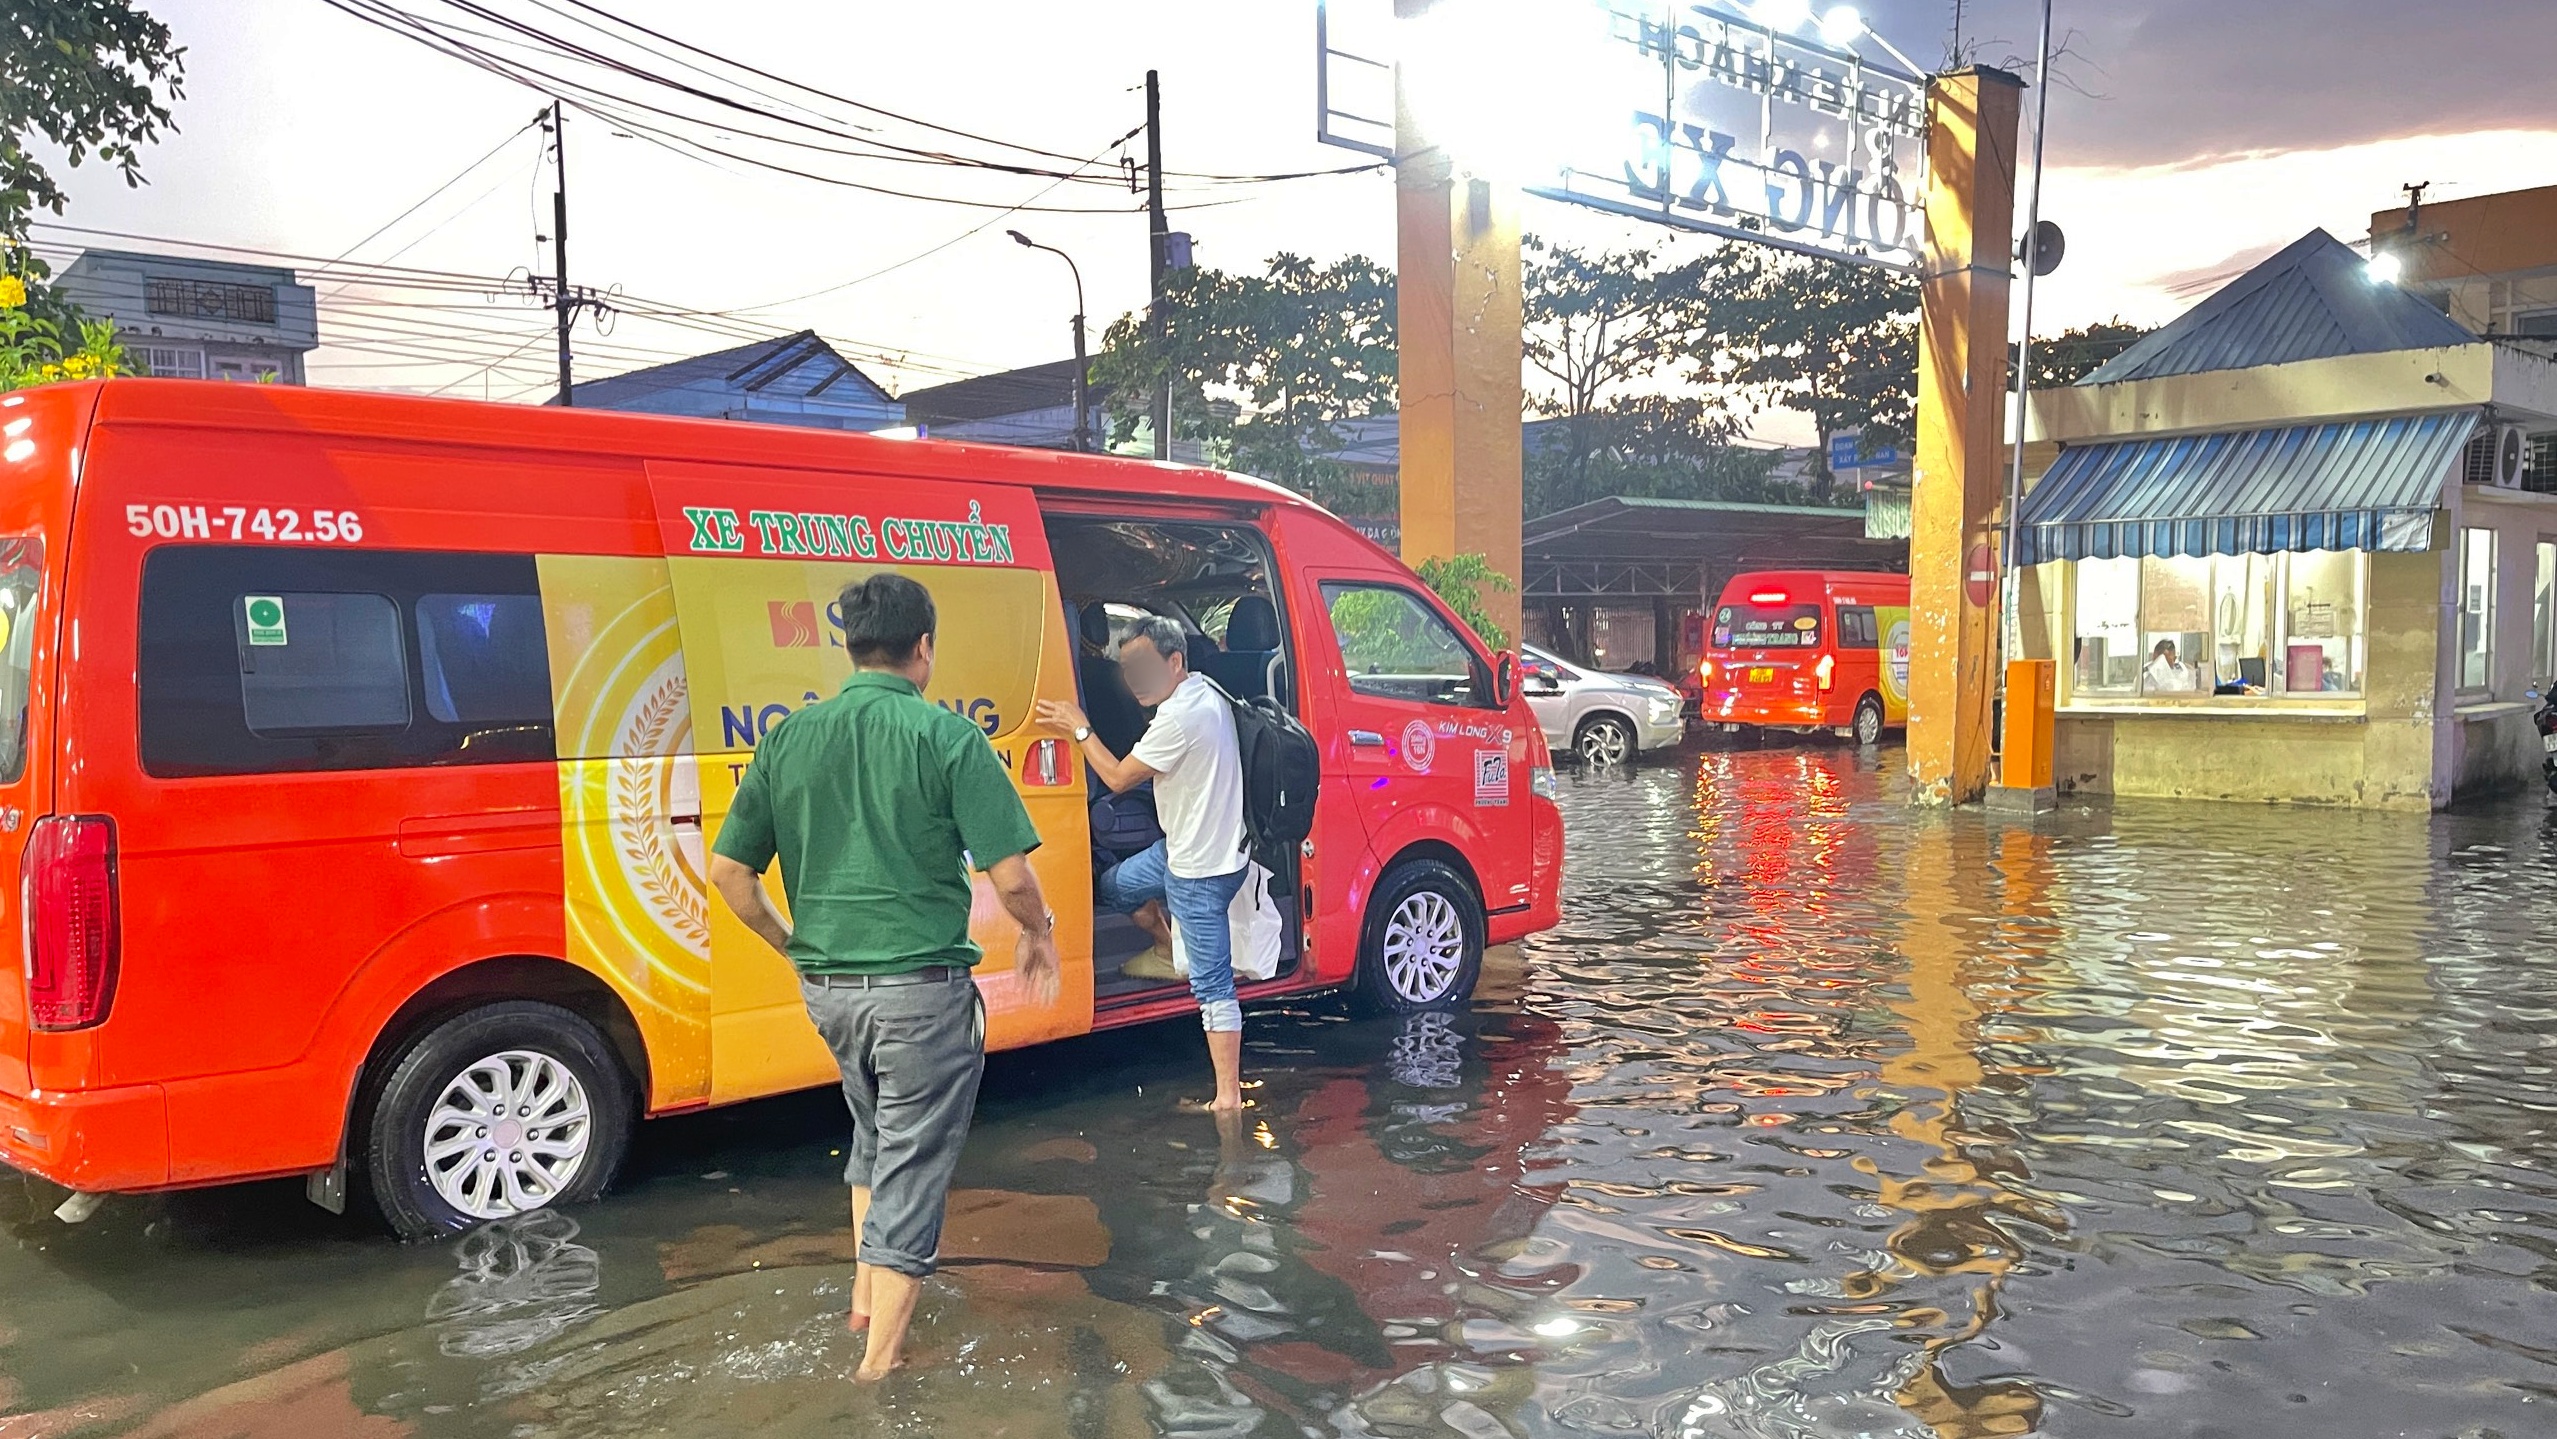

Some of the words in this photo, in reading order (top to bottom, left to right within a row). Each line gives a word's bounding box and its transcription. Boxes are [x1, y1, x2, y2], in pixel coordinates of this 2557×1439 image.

[126, 504, 363, 542] 50H-742.56
[684, 507, 745, 552] XE
[750, 510, 877, 558] TRUNG
[881, 499, 1014, 563] CHUYỂN
[1439, 721, 1459, 734] KIM
[1459, 724, 1487, 738] LONG
